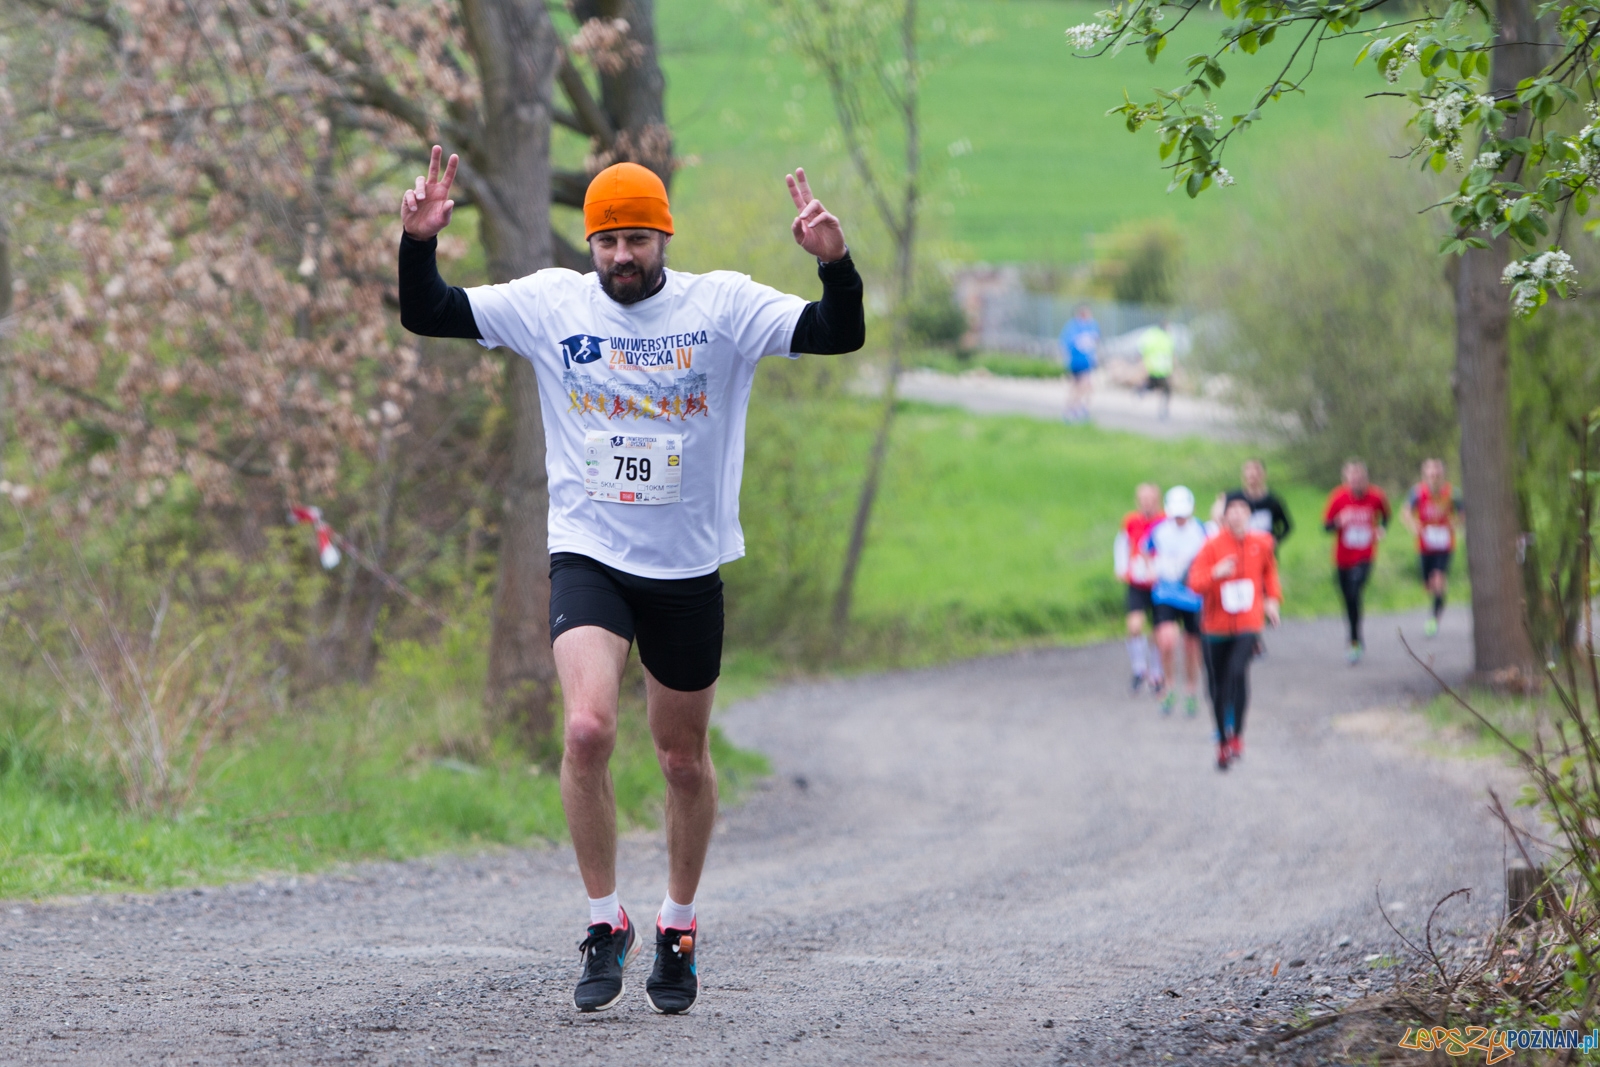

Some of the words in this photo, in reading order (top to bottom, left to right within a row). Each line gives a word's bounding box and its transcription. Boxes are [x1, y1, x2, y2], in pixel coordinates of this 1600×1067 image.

[610, 330, 708, 352] UNIWERSYTECKA
[609, 350, 673, 366] ZADYSZKA
[676, 347, 692, 369] IV
[614, 456, 651, 481] 759
